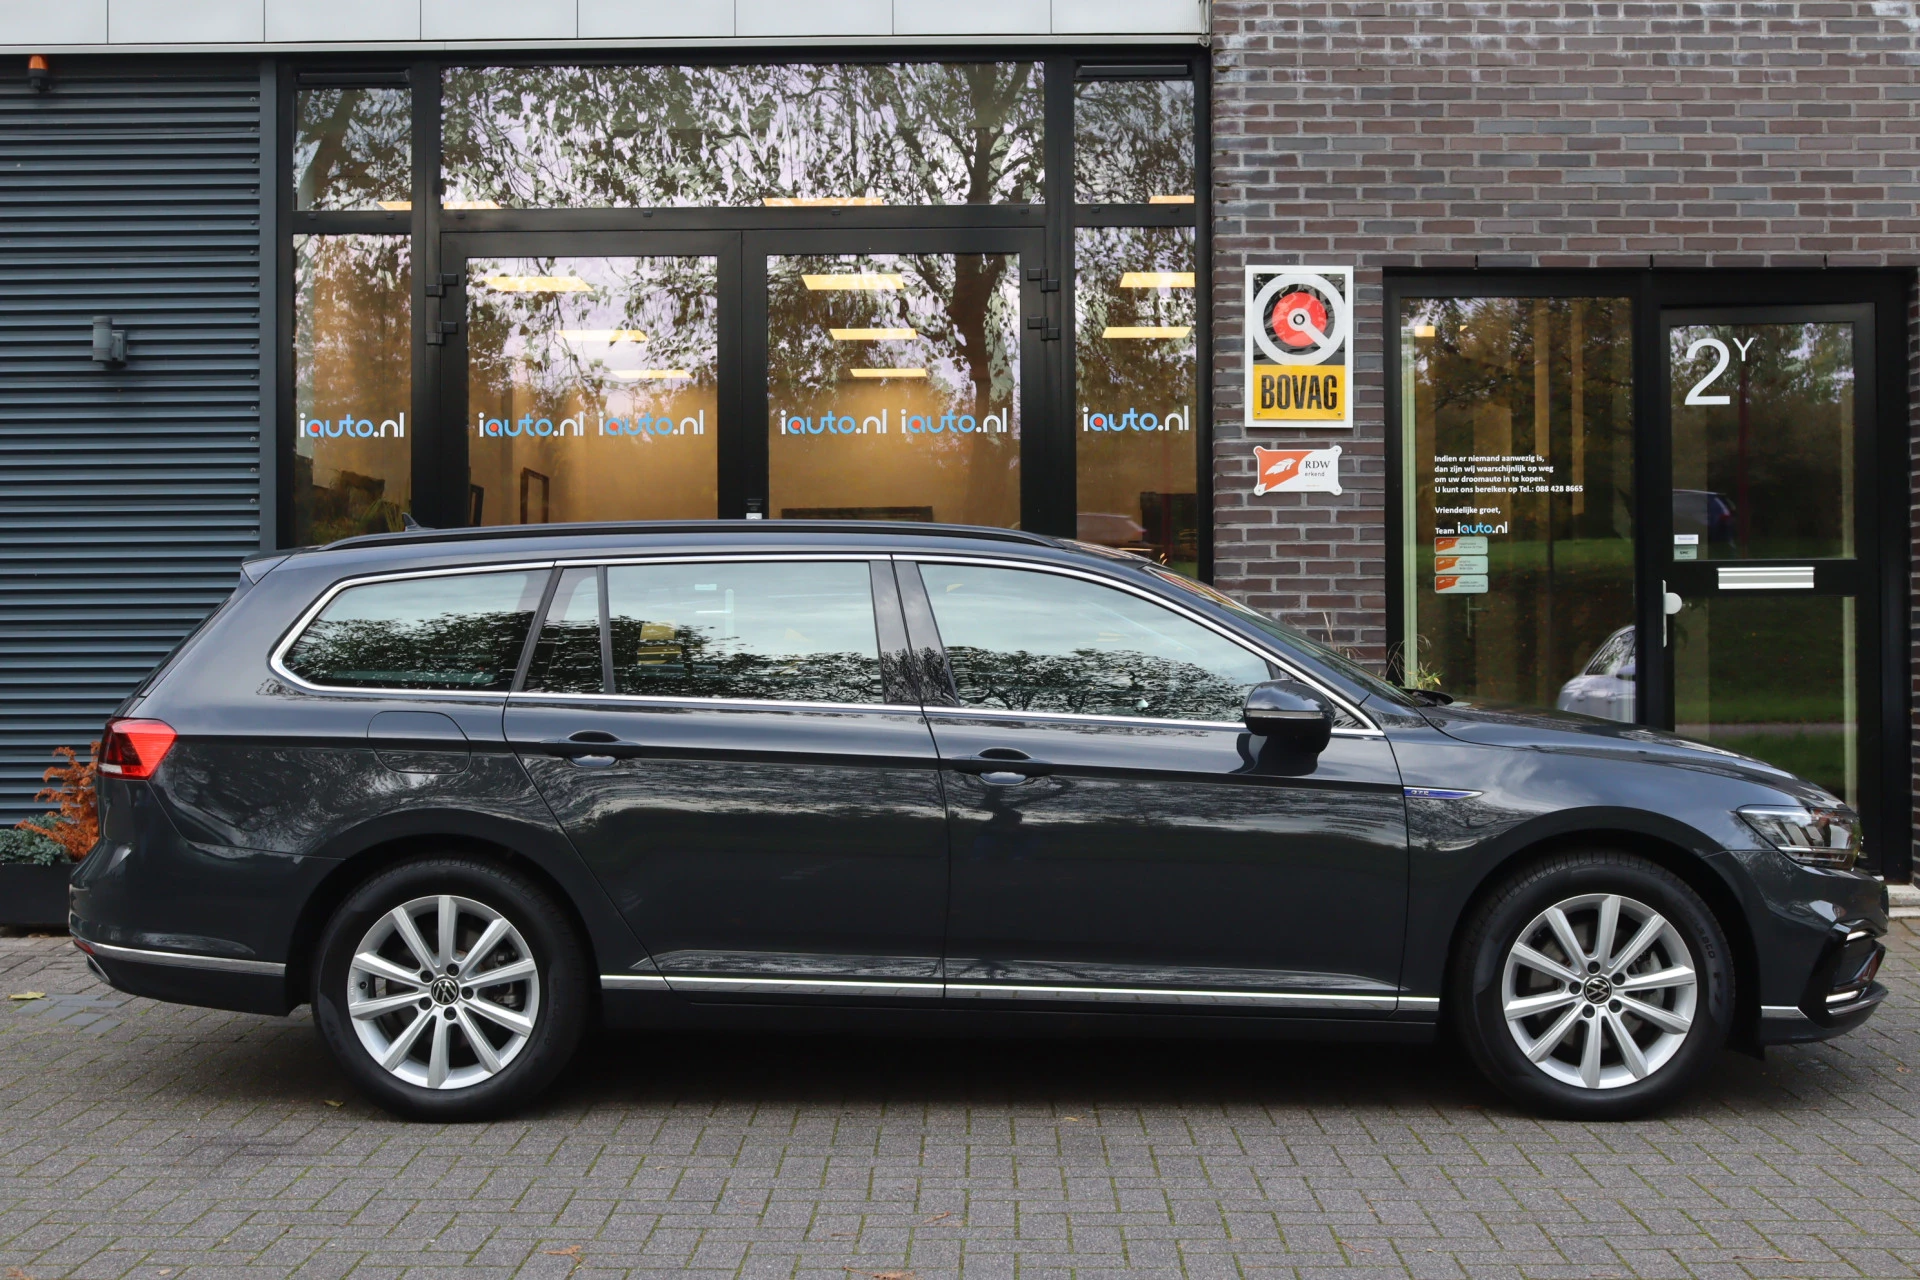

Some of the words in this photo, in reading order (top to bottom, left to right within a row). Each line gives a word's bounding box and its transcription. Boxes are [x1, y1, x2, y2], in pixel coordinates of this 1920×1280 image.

[1261, 374, 1338, 410] BOVAG
[300, 412, 404, 438] iauto.nl
[478, 411, 584, 437] iauto.nl
[598, 409, 704, 436] iauto.nl
[781, 408, 887, 434] iauto.nl
[901, 407, 1007, 433] iauto.nl
[1083, 405, 1189, 431] iauto.nl
[1305, 460, 1330, 469] RDW
[1477, 465, 1525, 473] waarschijnlijk
[1521, 475, 1545, 483] kopen.
[1435, 507, 1477, 515] Vriendelijke
[1479, 507, 1500, 515] groet,
[1457, 521, 1508, 534] iauto.nl
